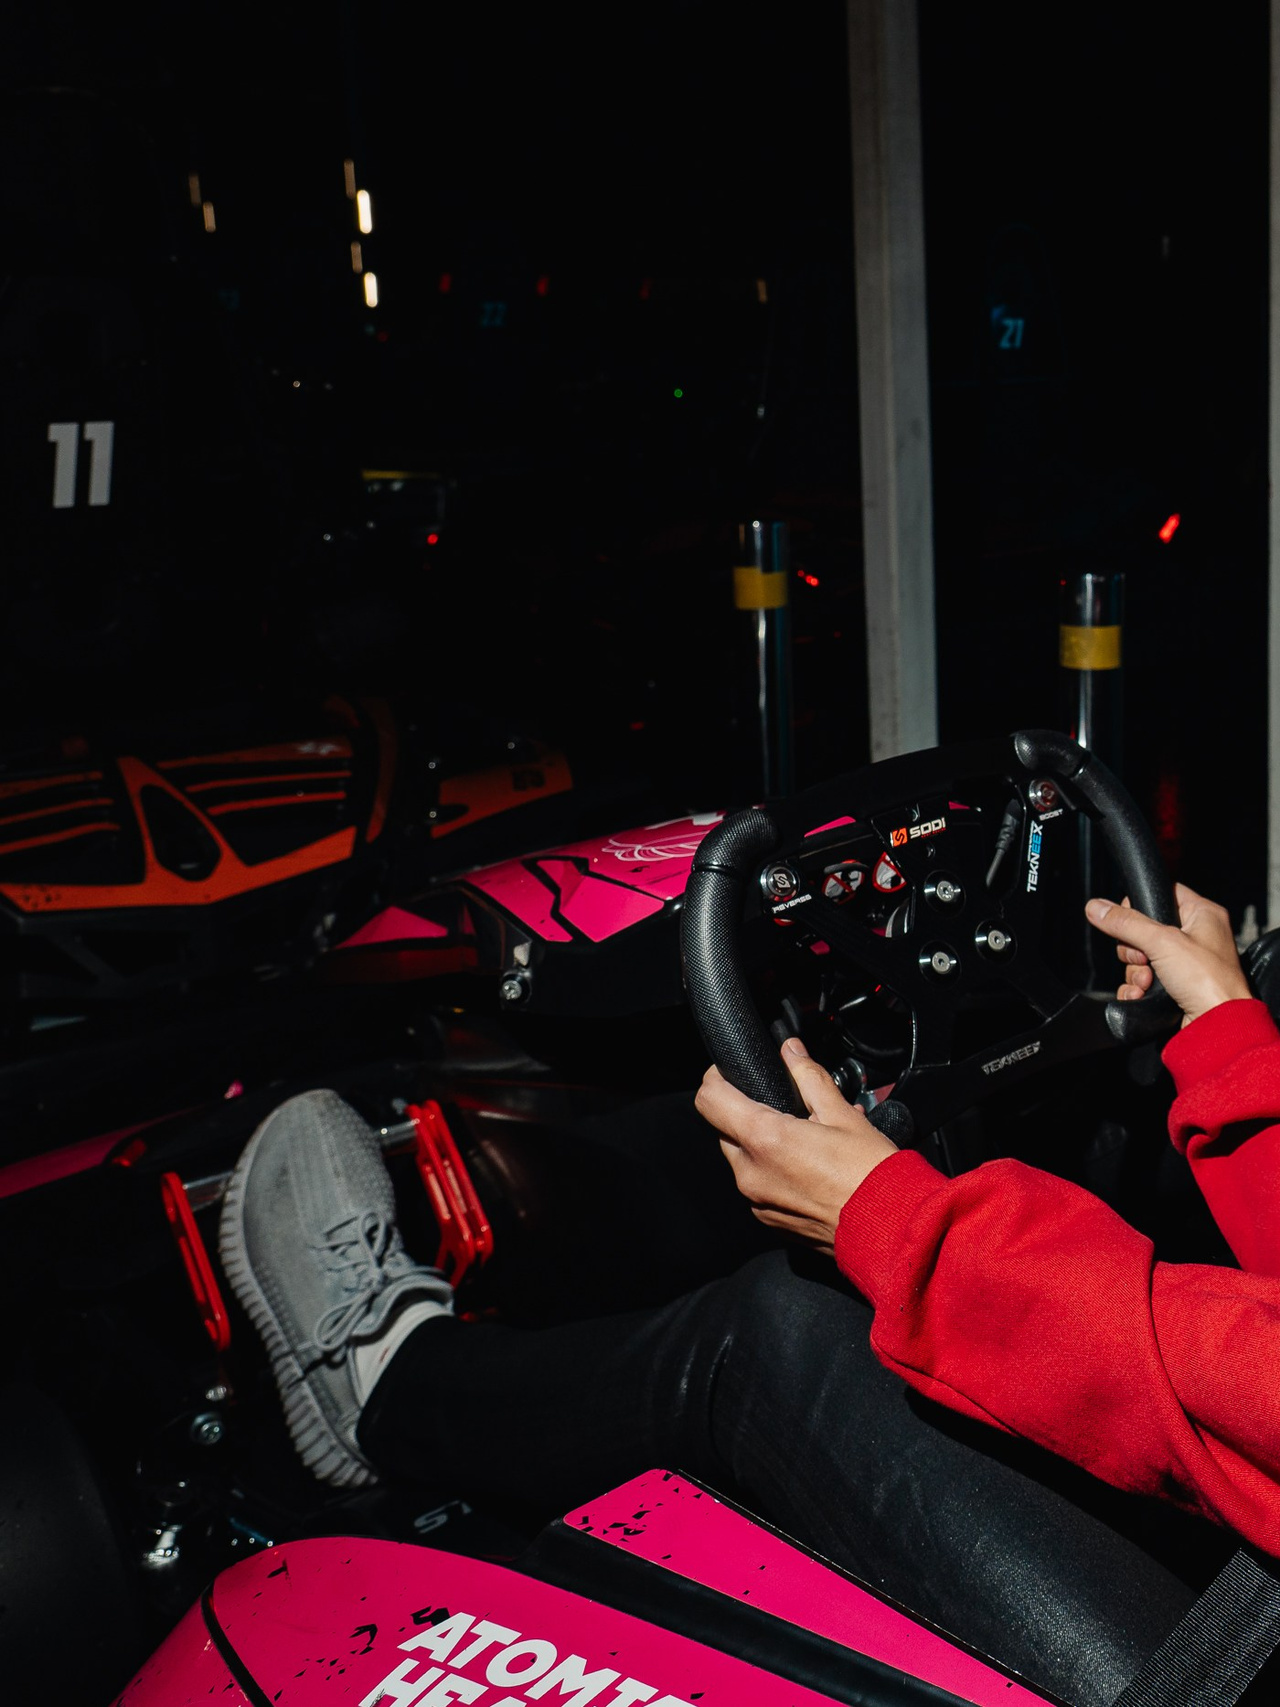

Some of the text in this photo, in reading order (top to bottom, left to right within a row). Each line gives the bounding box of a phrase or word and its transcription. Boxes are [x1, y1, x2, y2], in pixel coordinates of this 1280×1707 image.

[47, 420, 115, 509] 11
[909, 817, 946, 839] SODI
[1026, 820, 1044, 893] TEKNEEX
[357, 1657, 528, 1707] HE
[397, 1611, 699, 1707] ATOMI
